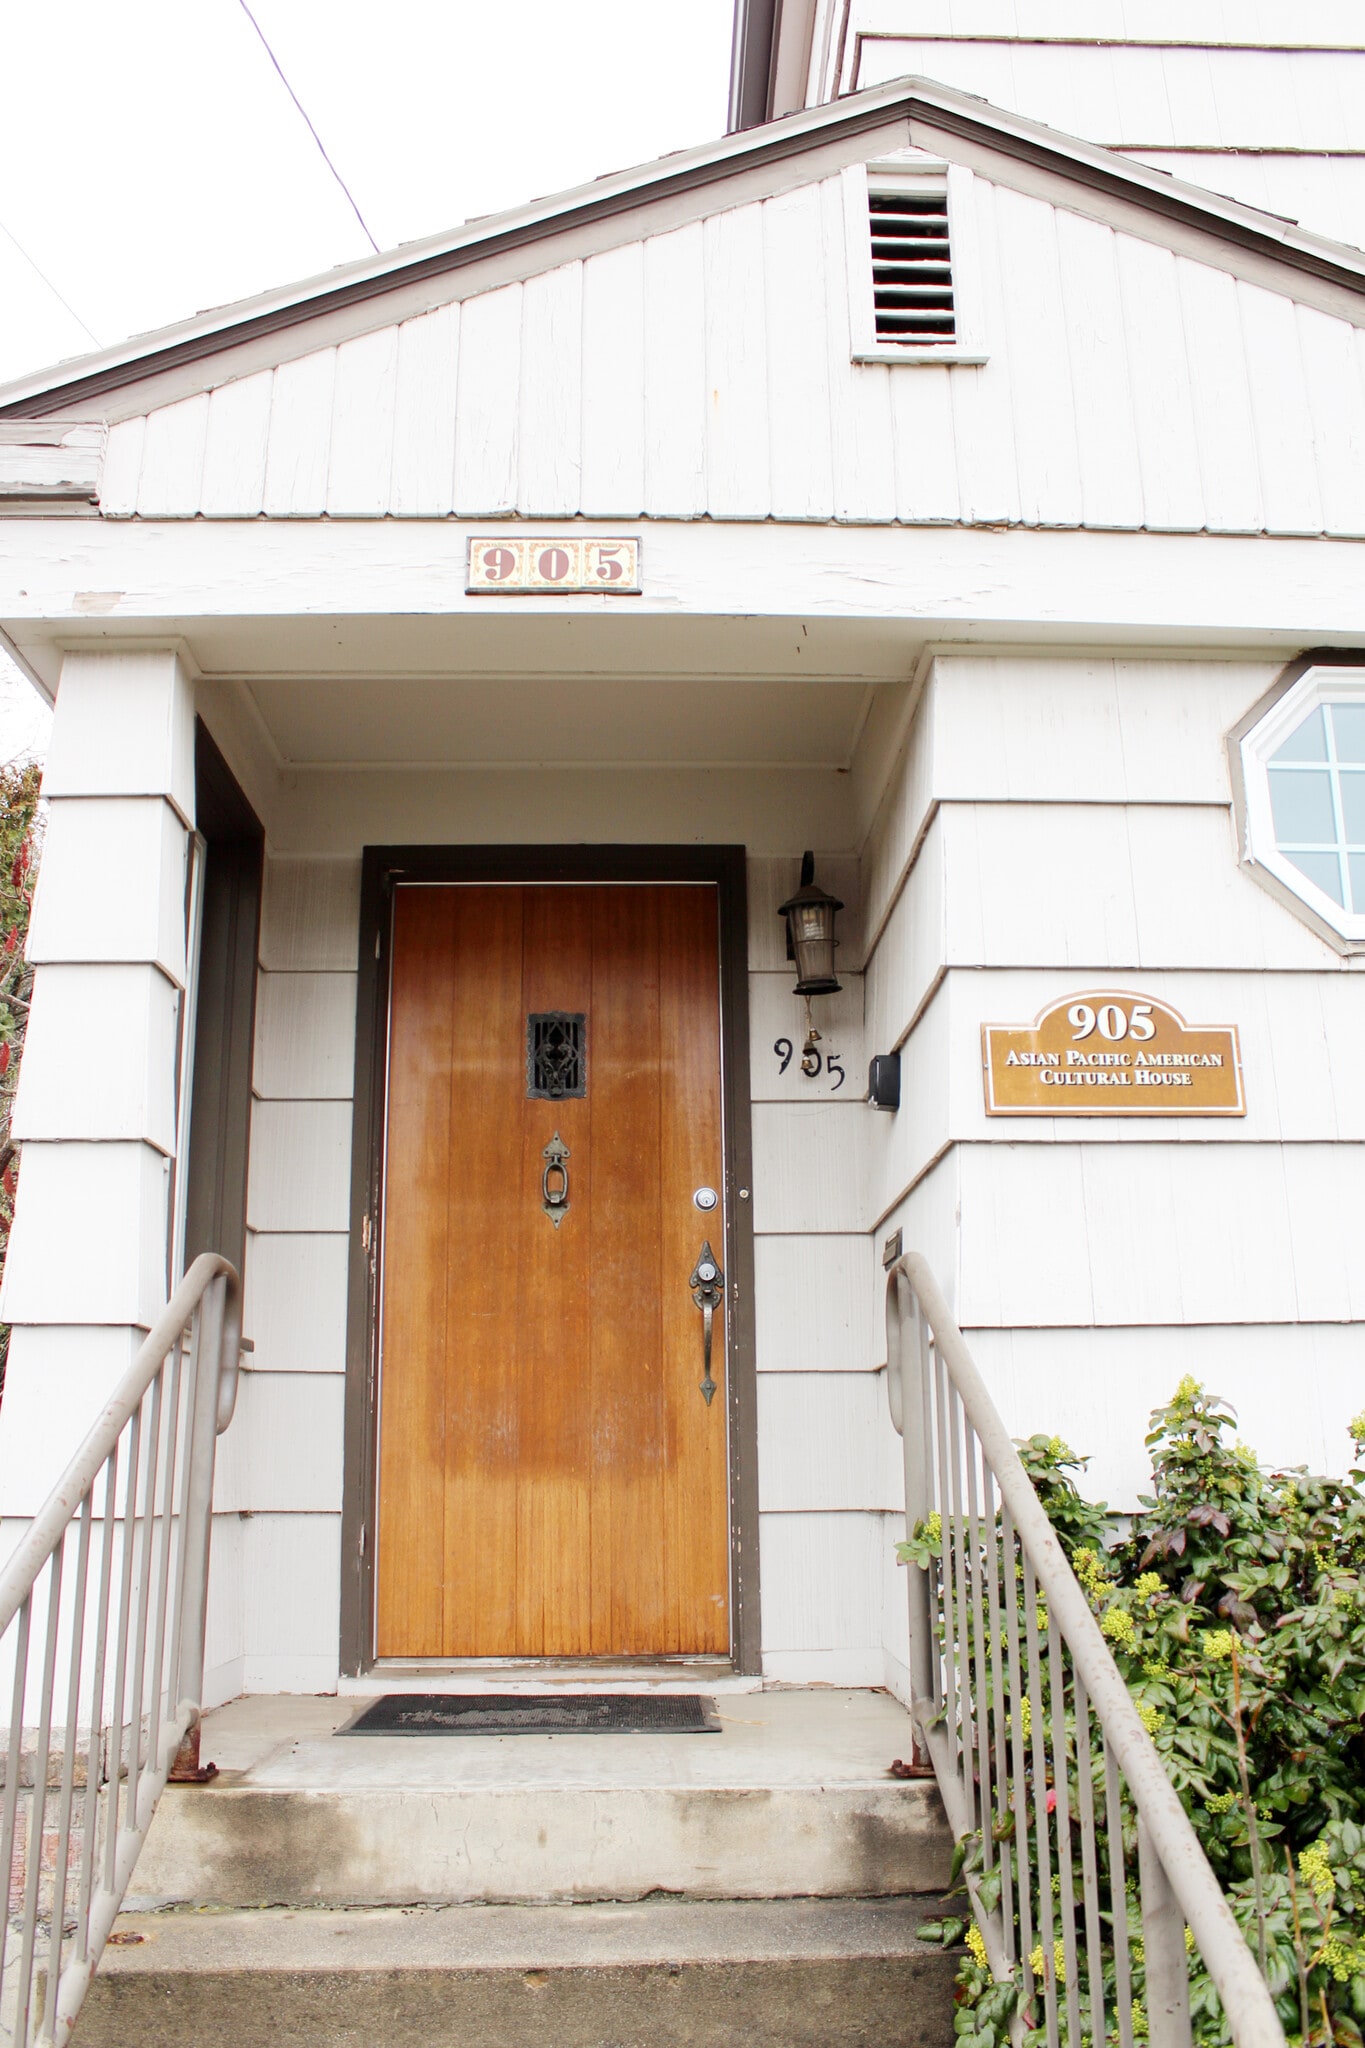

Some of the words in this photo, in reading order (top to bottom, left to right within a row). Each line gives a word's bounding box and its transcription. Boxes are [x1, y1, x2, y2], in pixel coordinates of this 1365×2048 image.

[483, 548, 623, 581] 905
[1067, 1004, 1156, 1041] 905
[1005, 1050, 1062, 1067] ASIAN
[1065, 1050, 1132, 1067] PACIFIC
[1134, 1050, 1224, 1067] AMERICAN
[1039, 1069, 1132, 1086] CULTURAL
[1134, 1069, 1193, 1086] HOUSE
